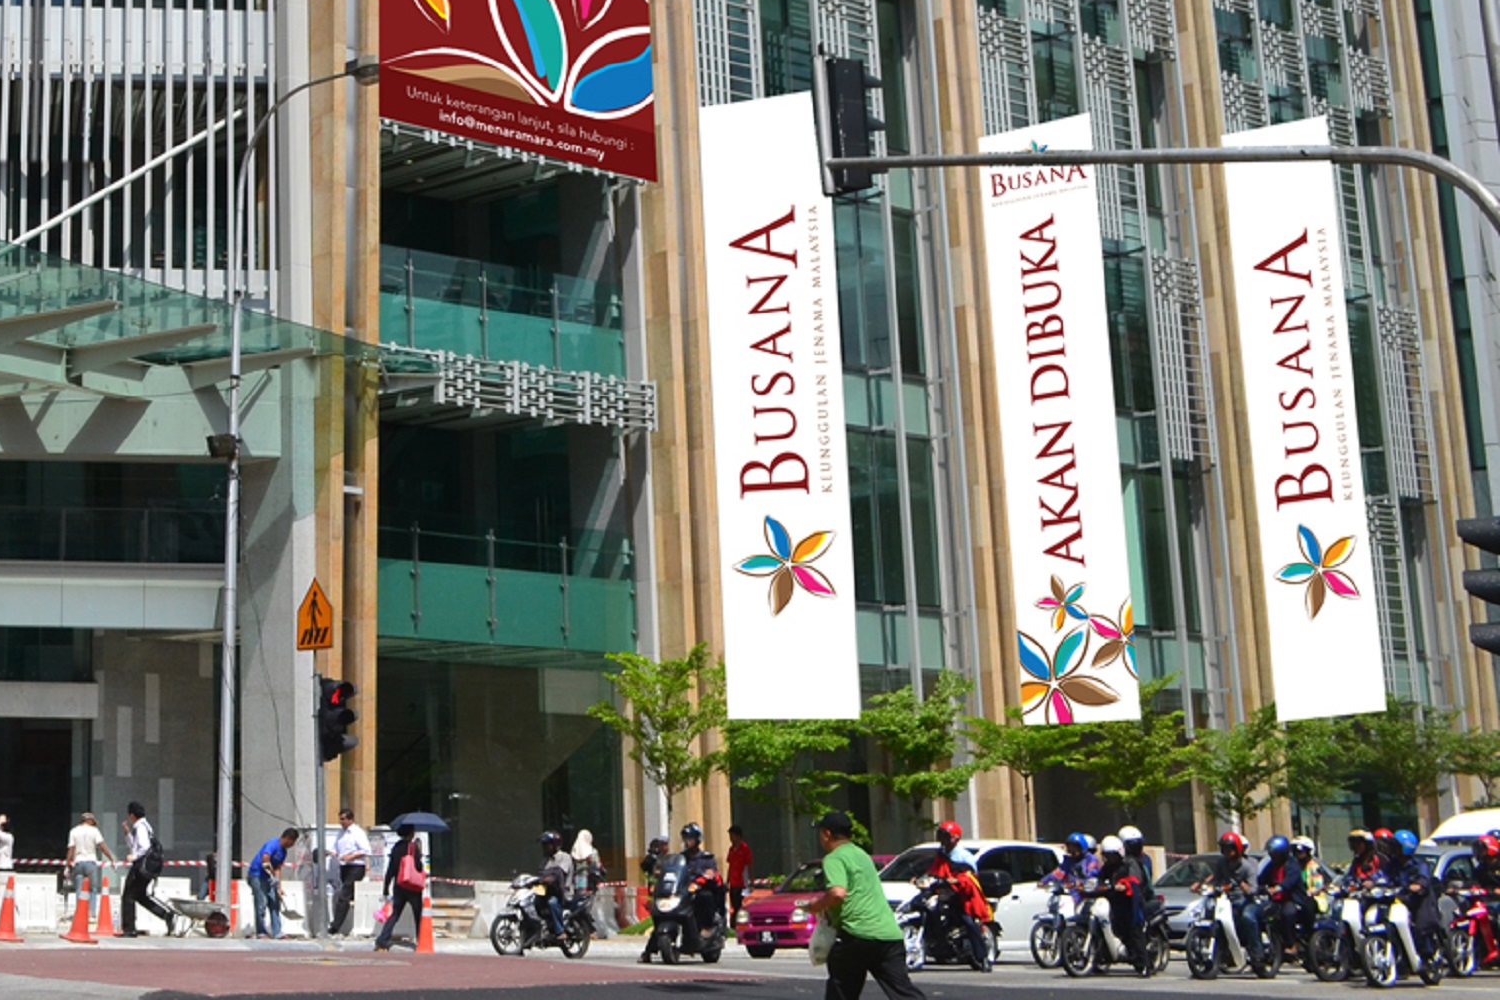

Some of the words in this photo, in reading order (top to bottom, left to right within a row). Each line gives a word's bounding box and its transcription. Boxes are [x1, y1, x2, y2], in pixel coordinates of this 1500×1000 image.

[406, 85, 443, 105] Untuk
[446, 94, 515, 122] keterangan
[517, 110, 554, 133] lanjut,
[557, 123, 577, 138] sila
[579, 129, 628, 150] hubungi
[438, 109, 605, 162] info@menaramara.com.my
[990, 164, 1088, 198] BUSANA
[808, 205, 822, 288] MALAYSIA
[1317, 228, 1334, 308] MALAYSIA
[813, 298, 828, 364] JENAMA
[1019, 213, 1070, 404] DIBUKA
[1324, 315, 1342, 380] JENAMA
[729, 205, 811, 499] BUSANA
[1253, 228, 1334, 511] BUSANA
[1034, 421, 1085, 567] AKAN
